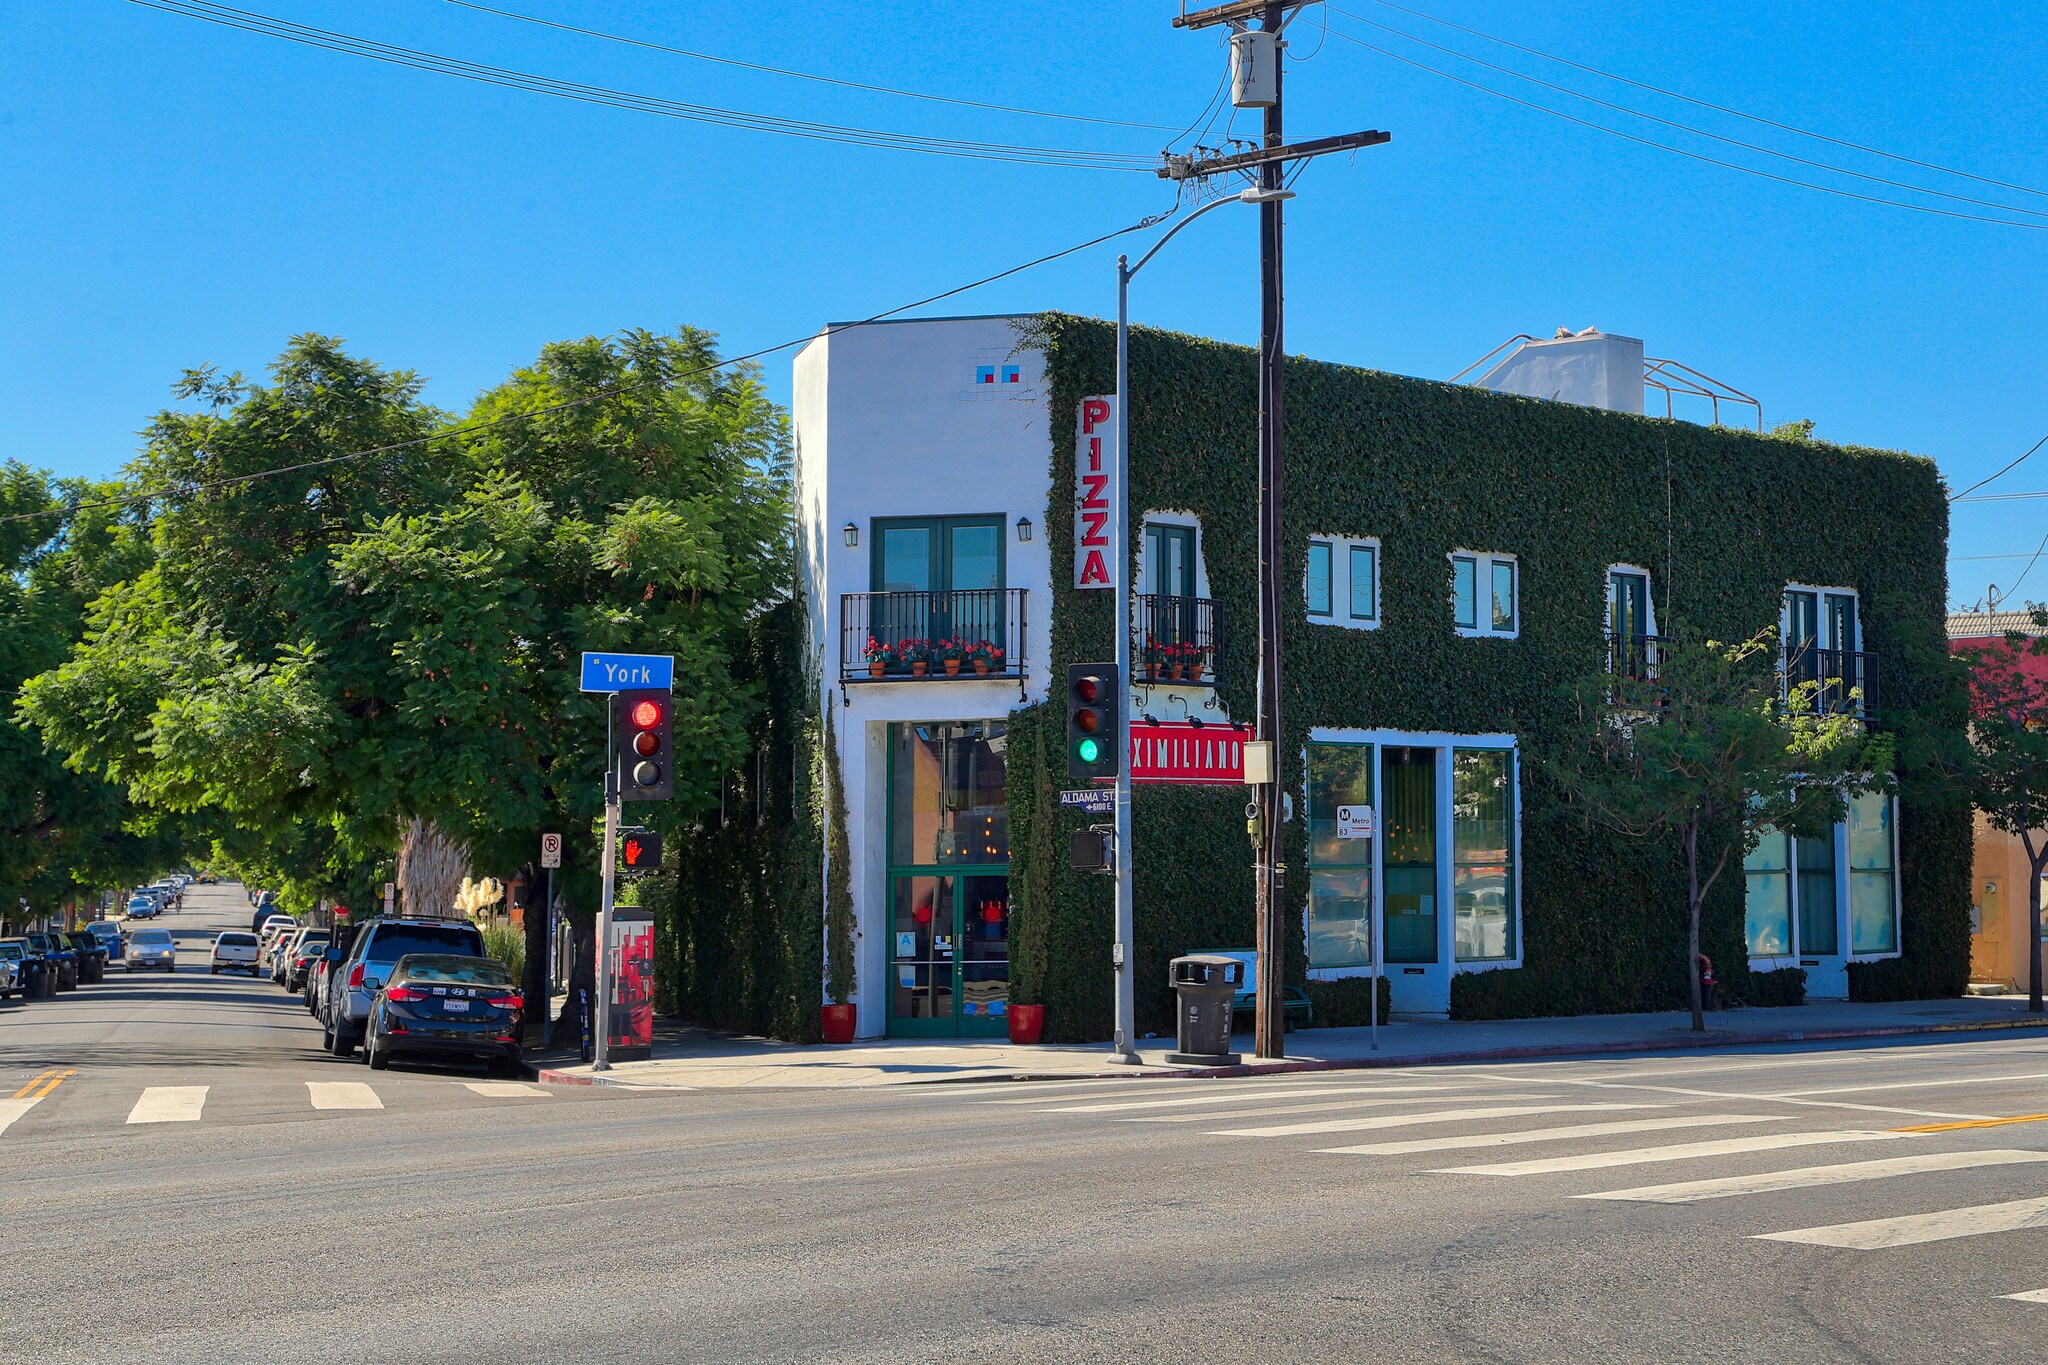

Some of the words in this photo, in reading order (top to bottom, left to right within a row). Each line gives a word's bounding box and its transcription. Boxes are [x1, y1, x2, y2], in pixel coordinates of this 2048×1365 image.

[1080, 400, 1110, 585] PIZZA
[604, 663, 651, 684] York
[1132, 738, 1239, 769] XIMILIANO
[1061, 792, 1099, 804] ALDAMA
[1092, 803, 1106, 811] 6100
[1339, 828, 1348, 836] 83
[901, 934, 911, 946] A
